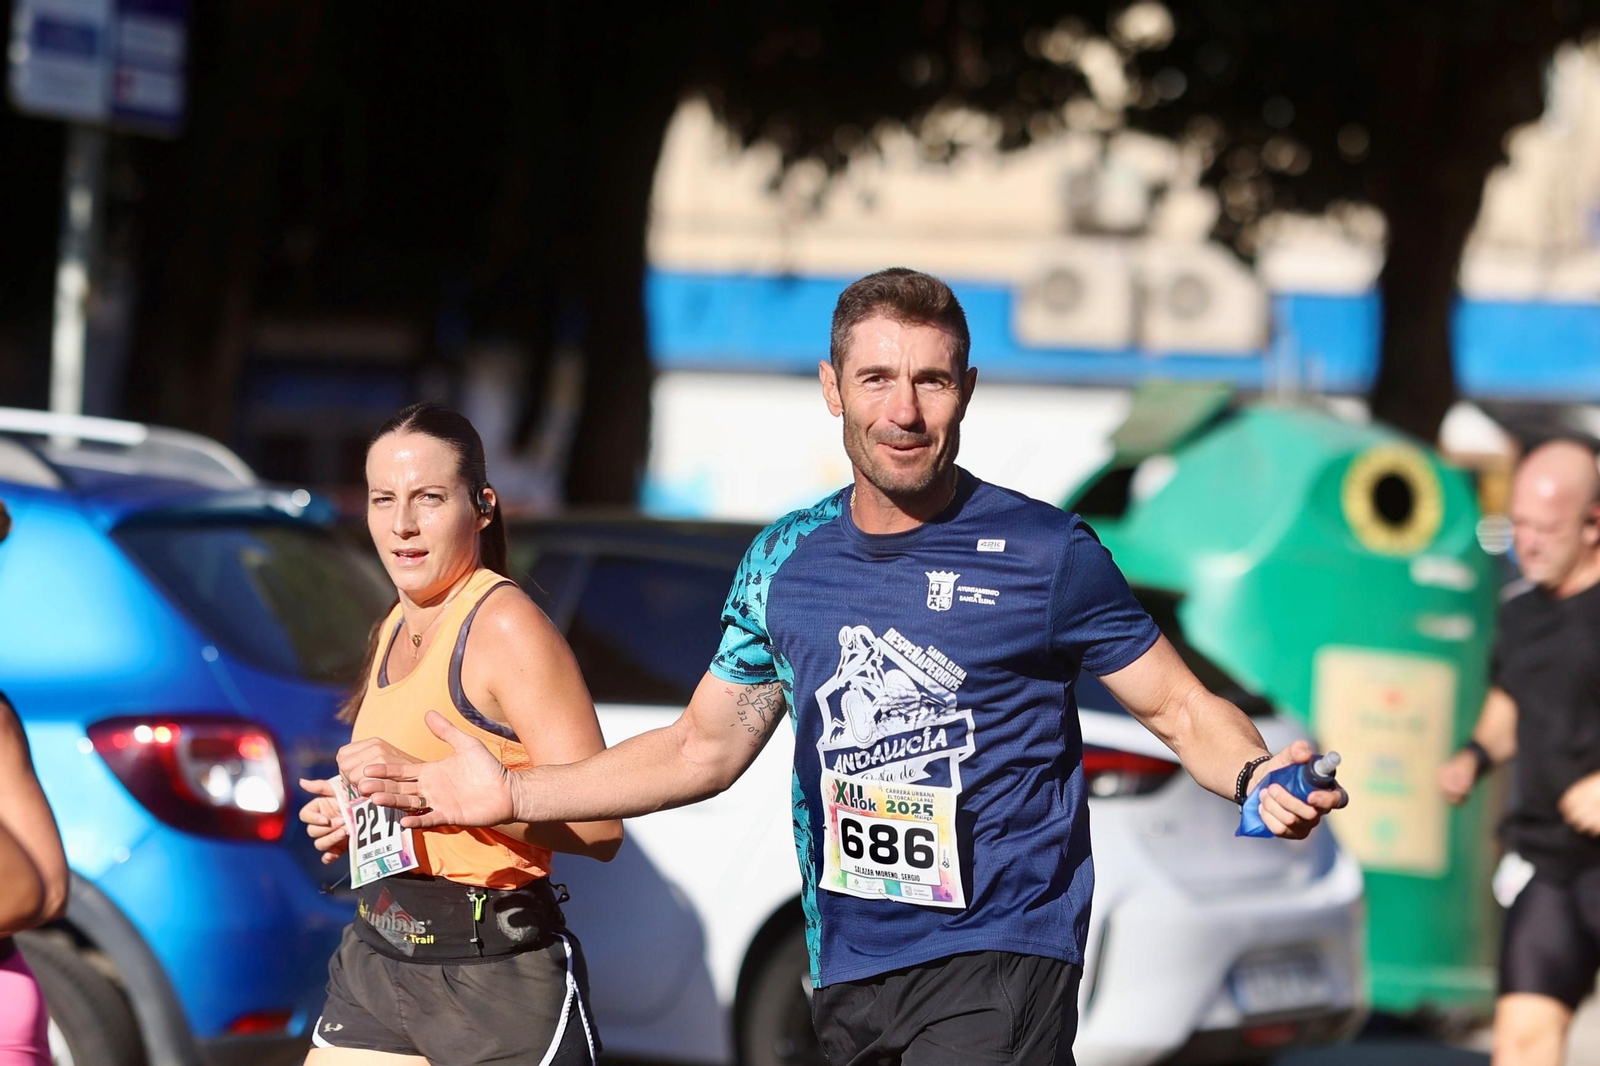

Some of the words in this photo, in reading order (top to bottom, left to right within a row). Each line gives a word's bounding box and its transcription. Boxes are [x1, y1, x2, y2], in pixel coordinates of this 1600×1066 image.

[957, 586, 1000, 597] AYUNTAMIENTO
[959, 595, 978, 604] SANTA
[979, 597, 996, 606] ELENA
[882, 627, 963, 692] DESPEÑAPERROS
[926, 645, 949, 668] SANTA
[945, 660, 968, 681] ELENA
[833, 727, 948, 774] ANDALUCÍA
[886, 788, 911, 796] CARRERA
[852, 797, 877, 811] 10k
[886, 799, 934, 817] 2025
[841, 817, 935, 869] 686
[854, 865, 874, 877] SALAZAR
[901, 872, 920, 883] SERGIO
[409, 934, 435, 945] Trail
